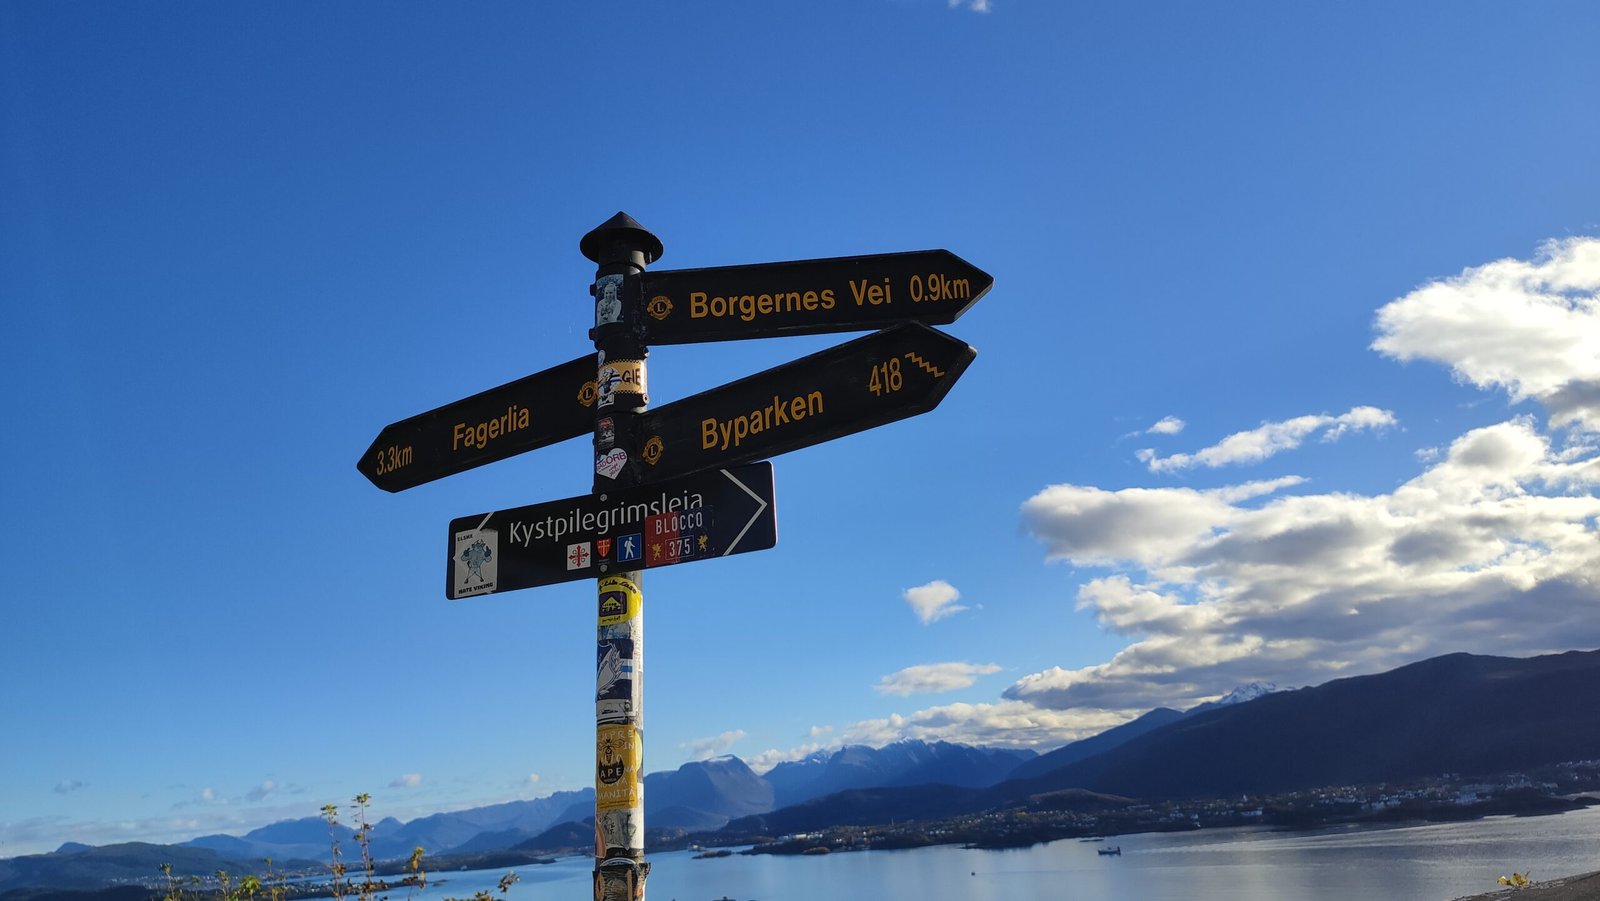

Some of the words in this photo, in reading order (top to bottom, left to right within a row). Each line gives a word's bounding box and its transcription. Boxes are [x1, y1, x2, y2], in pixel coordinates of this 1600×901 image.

[690, 287, 836, 322] Borgernes
[849, 277, 892, 306] Vei
[909, 273, 971, 303] 0.9km
[868, 357, 903, 397] 418
[453, 404, 530, 450] Fagerlia
[701, 390, 824, 451] Byparken
[376, 444, 413, 476] 3.3km
[509, 489, 703, 548] Kystpilegrimsleia
[655, 511, 703, 535] BLOCCO
[669, 538, 691, 557] 375
[600, 767, 622, 779] APE
